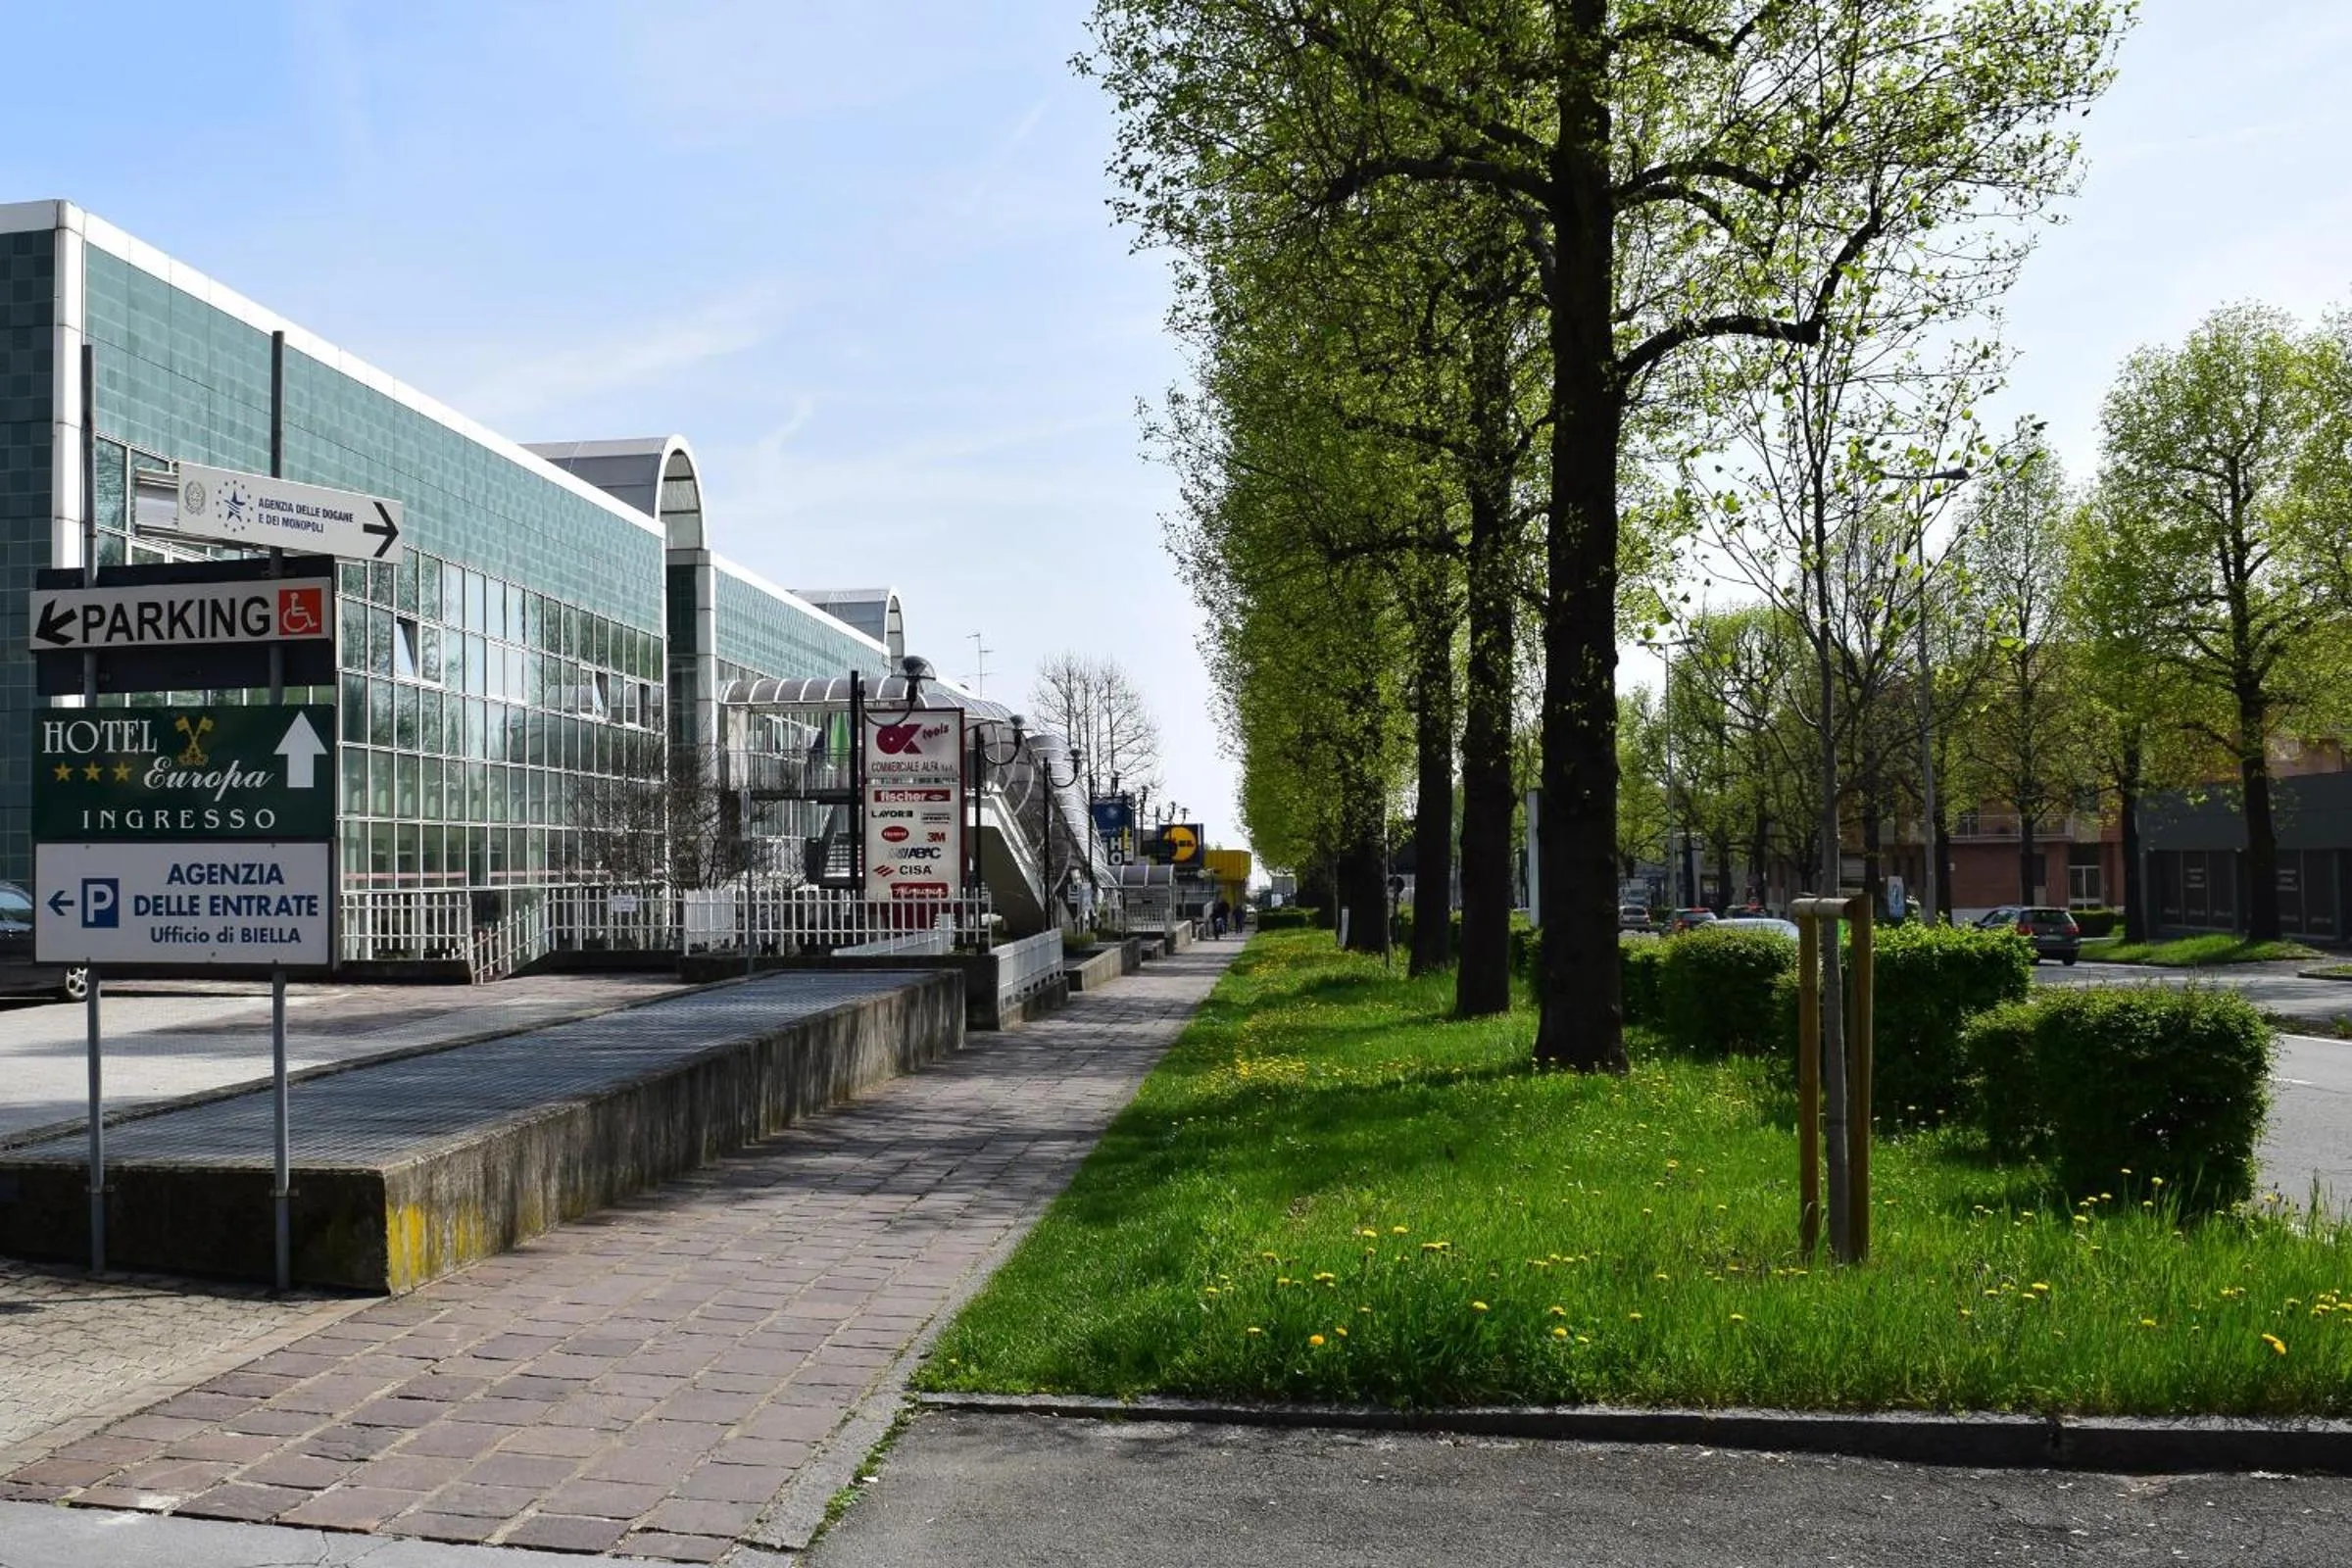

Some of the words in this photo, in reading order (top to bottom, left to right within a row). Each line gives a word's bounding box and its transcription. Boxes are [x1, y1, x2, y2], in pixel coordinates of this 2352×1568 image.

[258, 498, 294, 513] AGENZIA
[296, 505, 321, 518] DELLE
[322, 509, 354, 523] DOGANE
[258, 514, 264, 523] E
[266, 514, 280, 526] DEI
[282, 516, 324, 533] MONOPOLI
[81, 596, 270, 644] PARKING
[42, 720, 158, 755] HOTEL
[143, 756, 274, 802] Europa
[881, 791, 927, 802] fischer
[83, 808, 275, 829] INGRESSO
[927, 832, 946, 842] 3M
[908, 847, 941, 858] ABAC
[167, 863, 284, 885] AGENZIA
[899, 864, 932, 875] CISA
[86, 884, 114, 923] P
[134, 895, 200, 916] DELLE
[209, 895, 318, 916] ENTRATE
[151, 926, 210, 943] Ufficio
[216, 926, 233, 943] di
[241, 928, 302, 943] BIELLA
